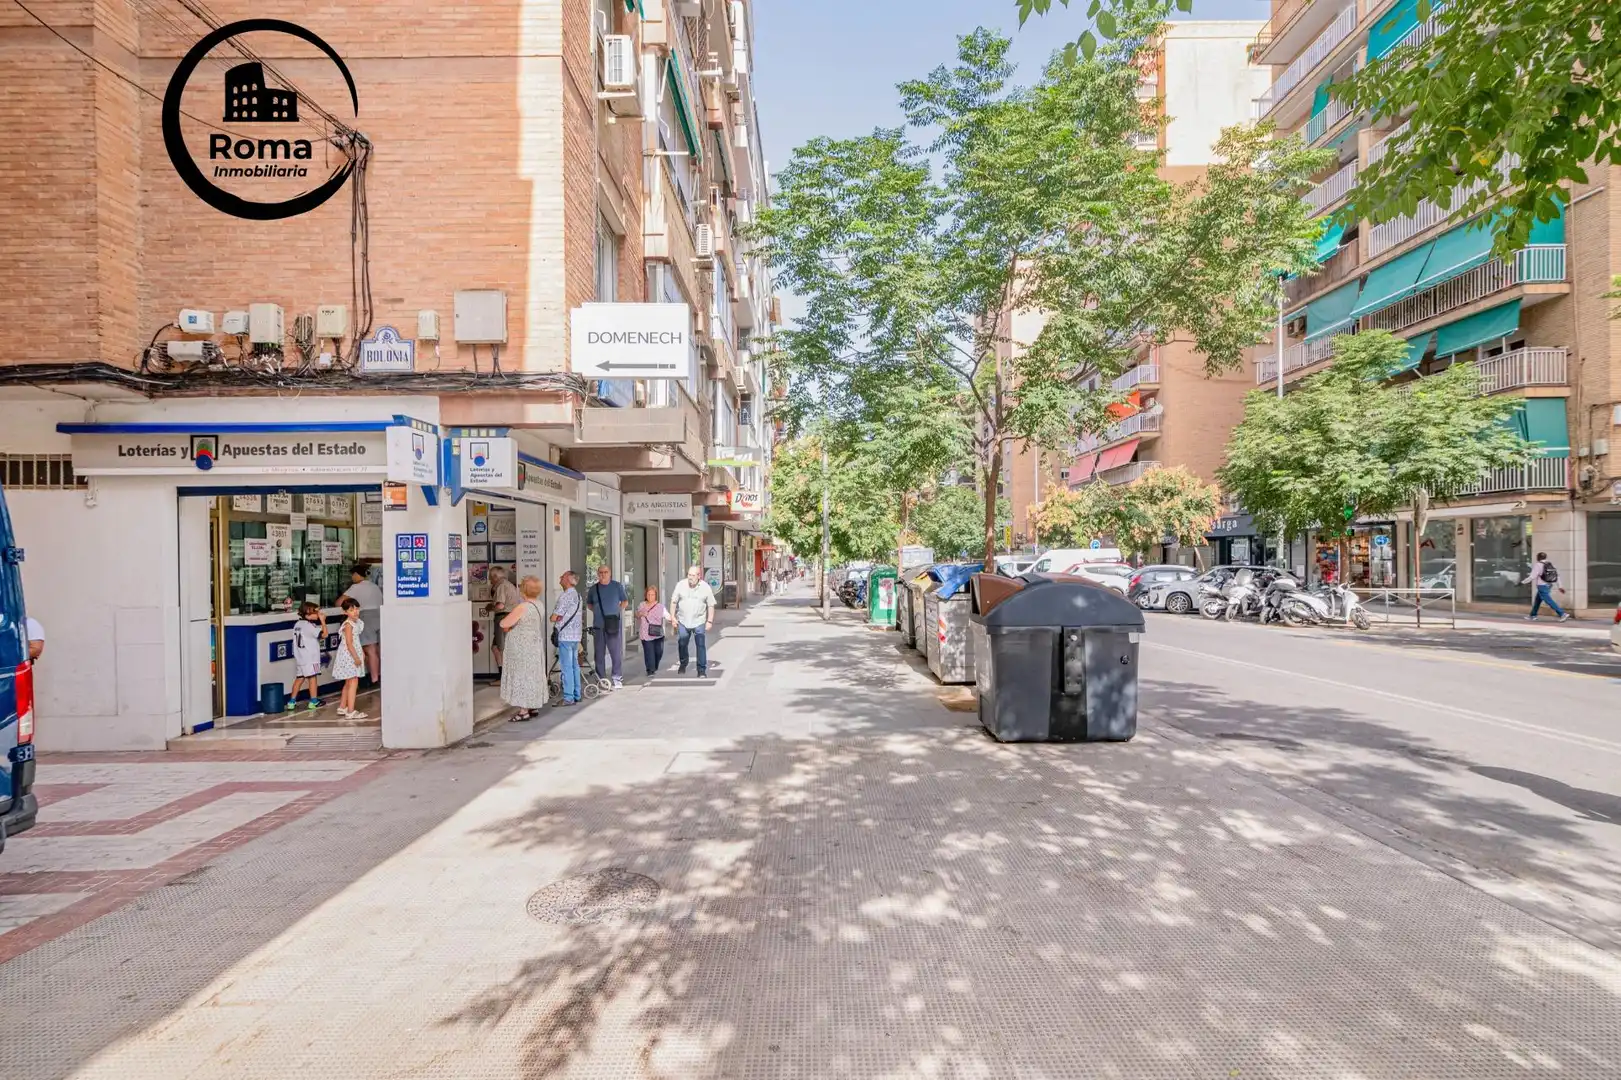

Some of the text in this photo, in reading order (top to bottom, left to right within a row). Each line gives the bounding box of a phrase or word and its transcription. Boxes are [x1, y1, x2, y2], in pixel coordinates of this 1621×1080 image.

[588, 331, 682, 344] DOMENECH
[366, 350, 409, 363] BOLONIA
[118, 441, 366, 460] Loterías y Apuestas del Estado
[650, 501, 687, 509] ANGUSTIAS
